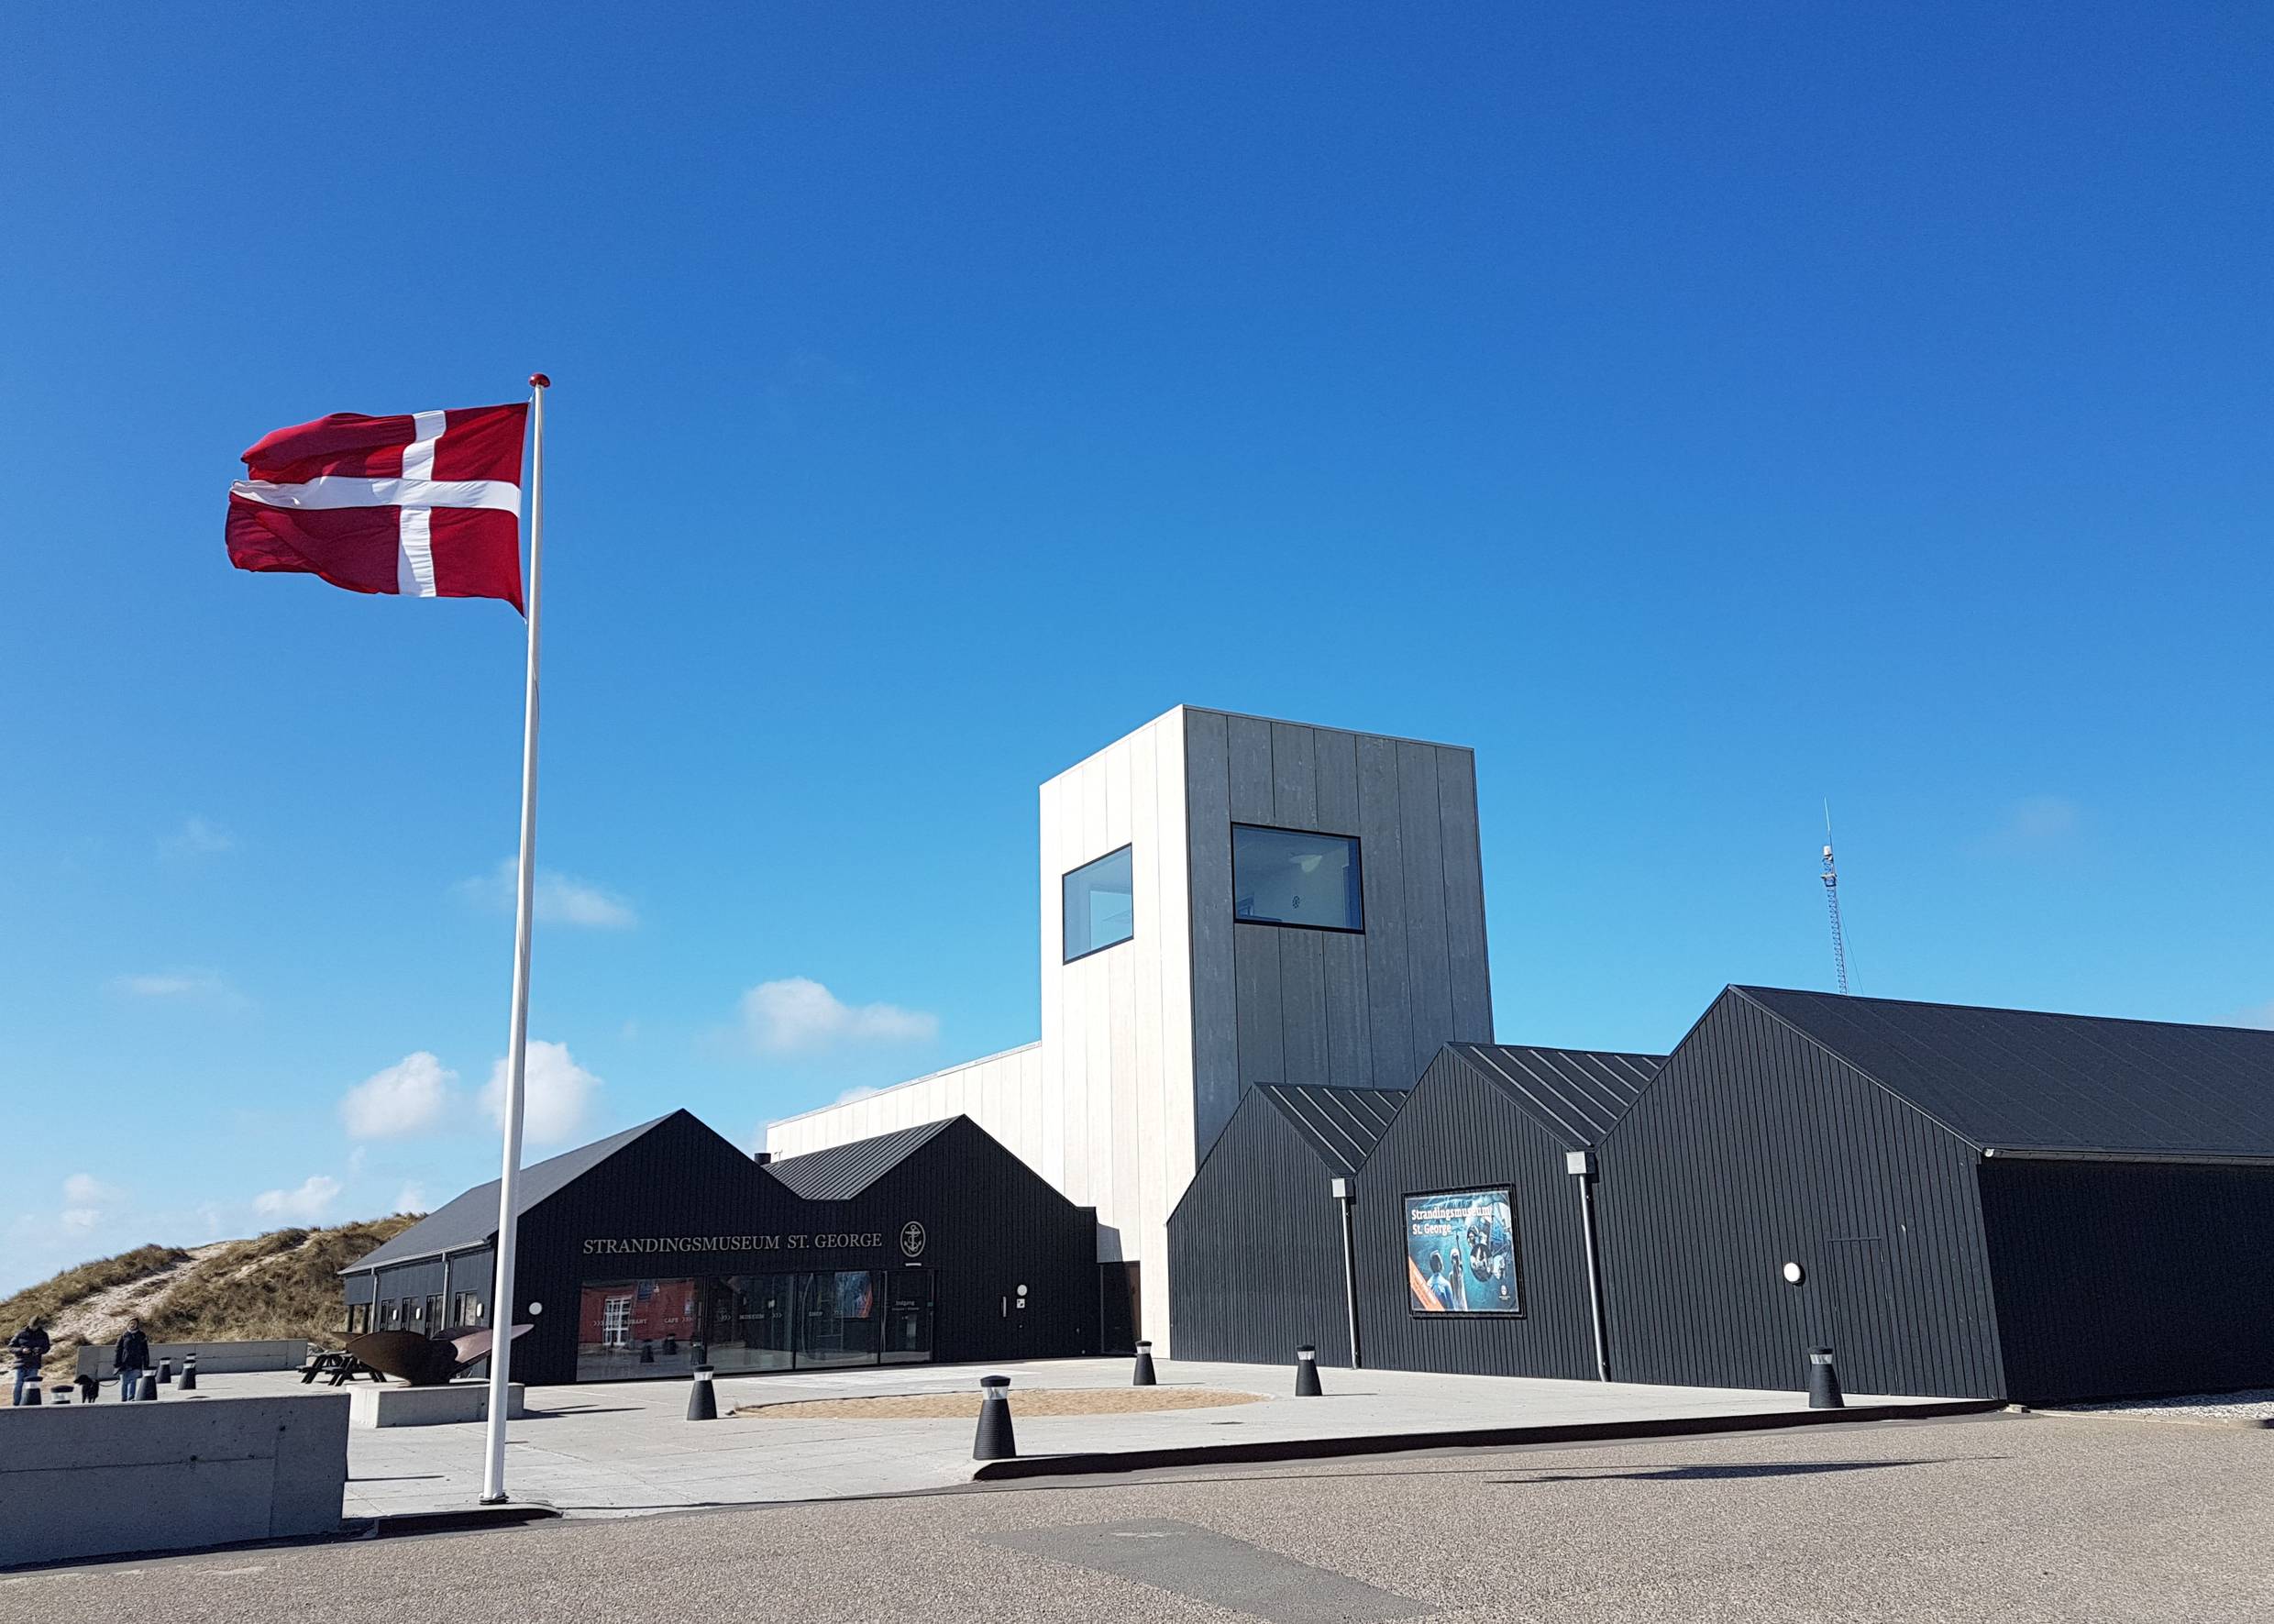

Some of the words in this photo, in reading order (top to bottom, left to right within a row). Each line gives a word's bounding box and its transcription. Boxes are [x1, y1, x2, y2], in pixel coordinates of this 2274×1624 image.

[1411, 1206, 1492, 1221] Strandingsmuseum
[1412, 1223, 1423, 1235] St.
[1424, 1222, 1452, 1236] George
[582, 1235, 780, 1254] STRANDINGSMUSEUM
[787, 1234, 811, 1249] ST.
[814, 1232, 883, 1248] GEORGE
